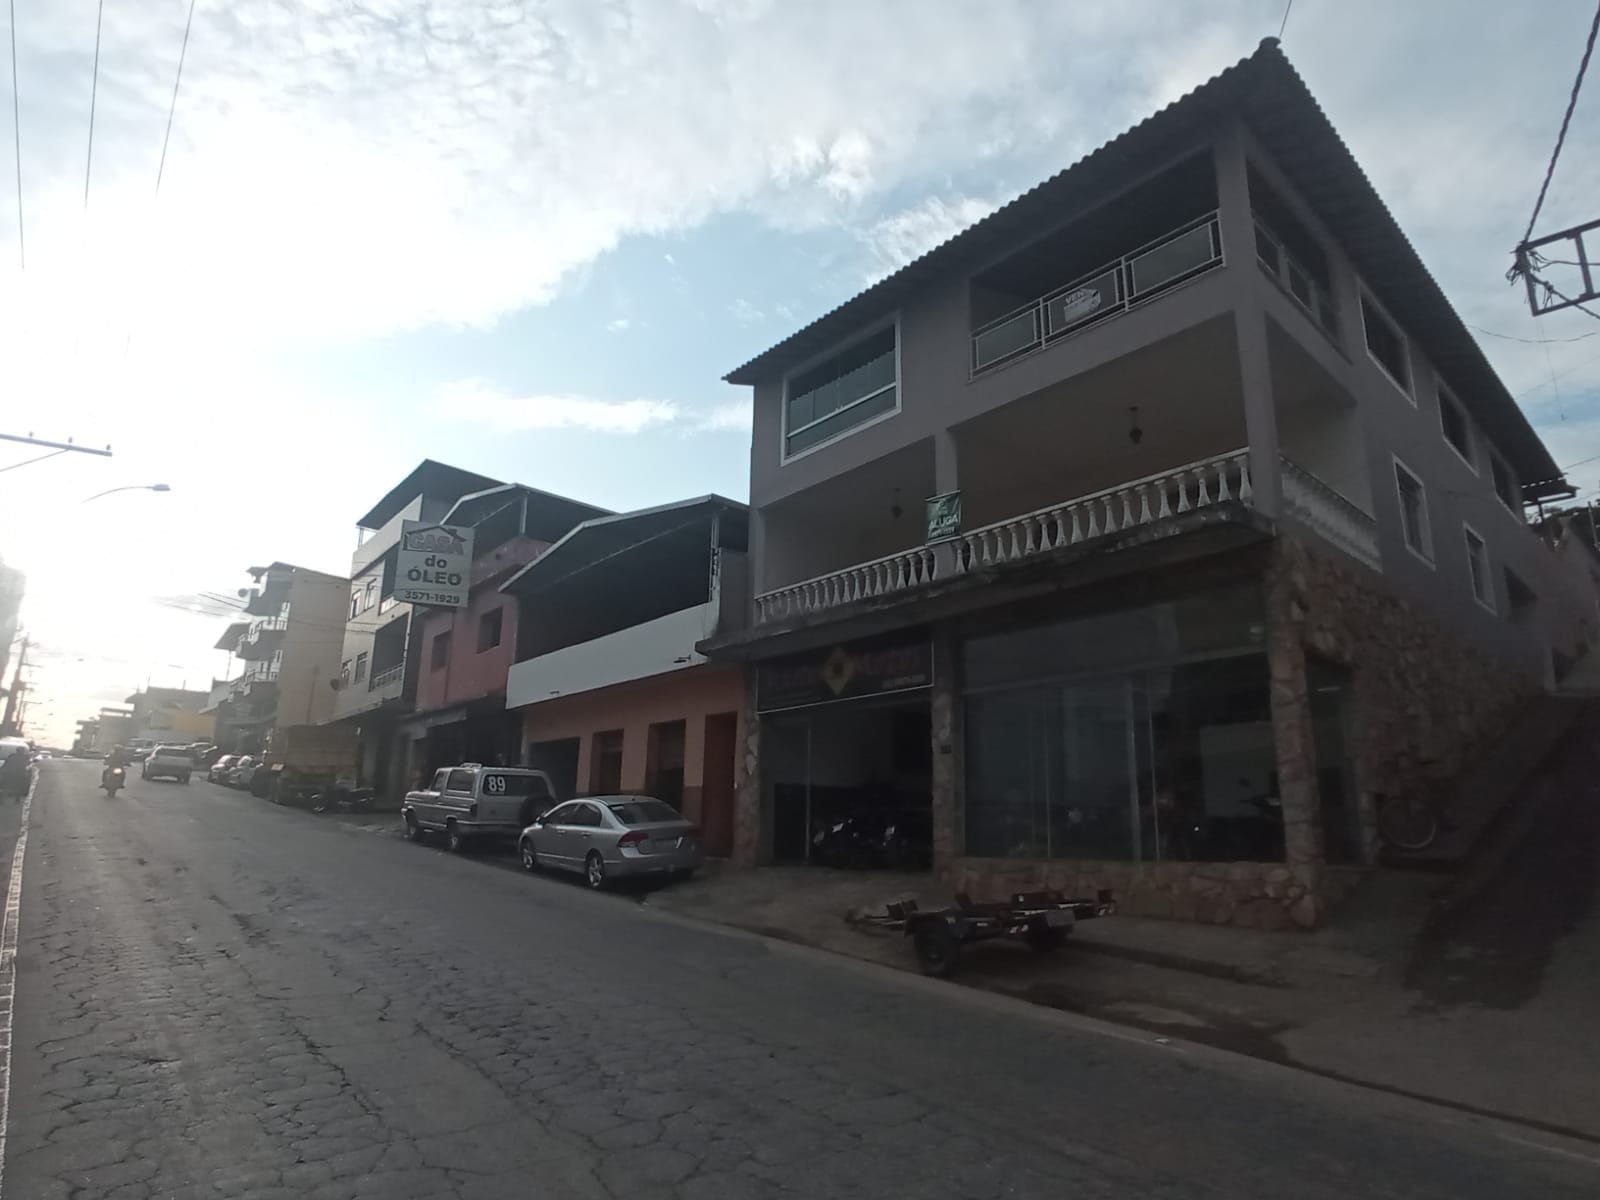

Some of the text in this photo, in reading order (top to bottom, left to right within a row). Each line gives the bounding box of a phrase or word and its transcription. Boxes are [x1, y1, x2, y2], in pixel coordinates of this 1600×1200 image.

[409, 532, 464, 555] CASA
[424, 555, 447, 568] do
[407, 566, 462, 586] ÓLEO
[404, 590, 460, 604] 3571-1929
[487, 775, 506, 792] 89
